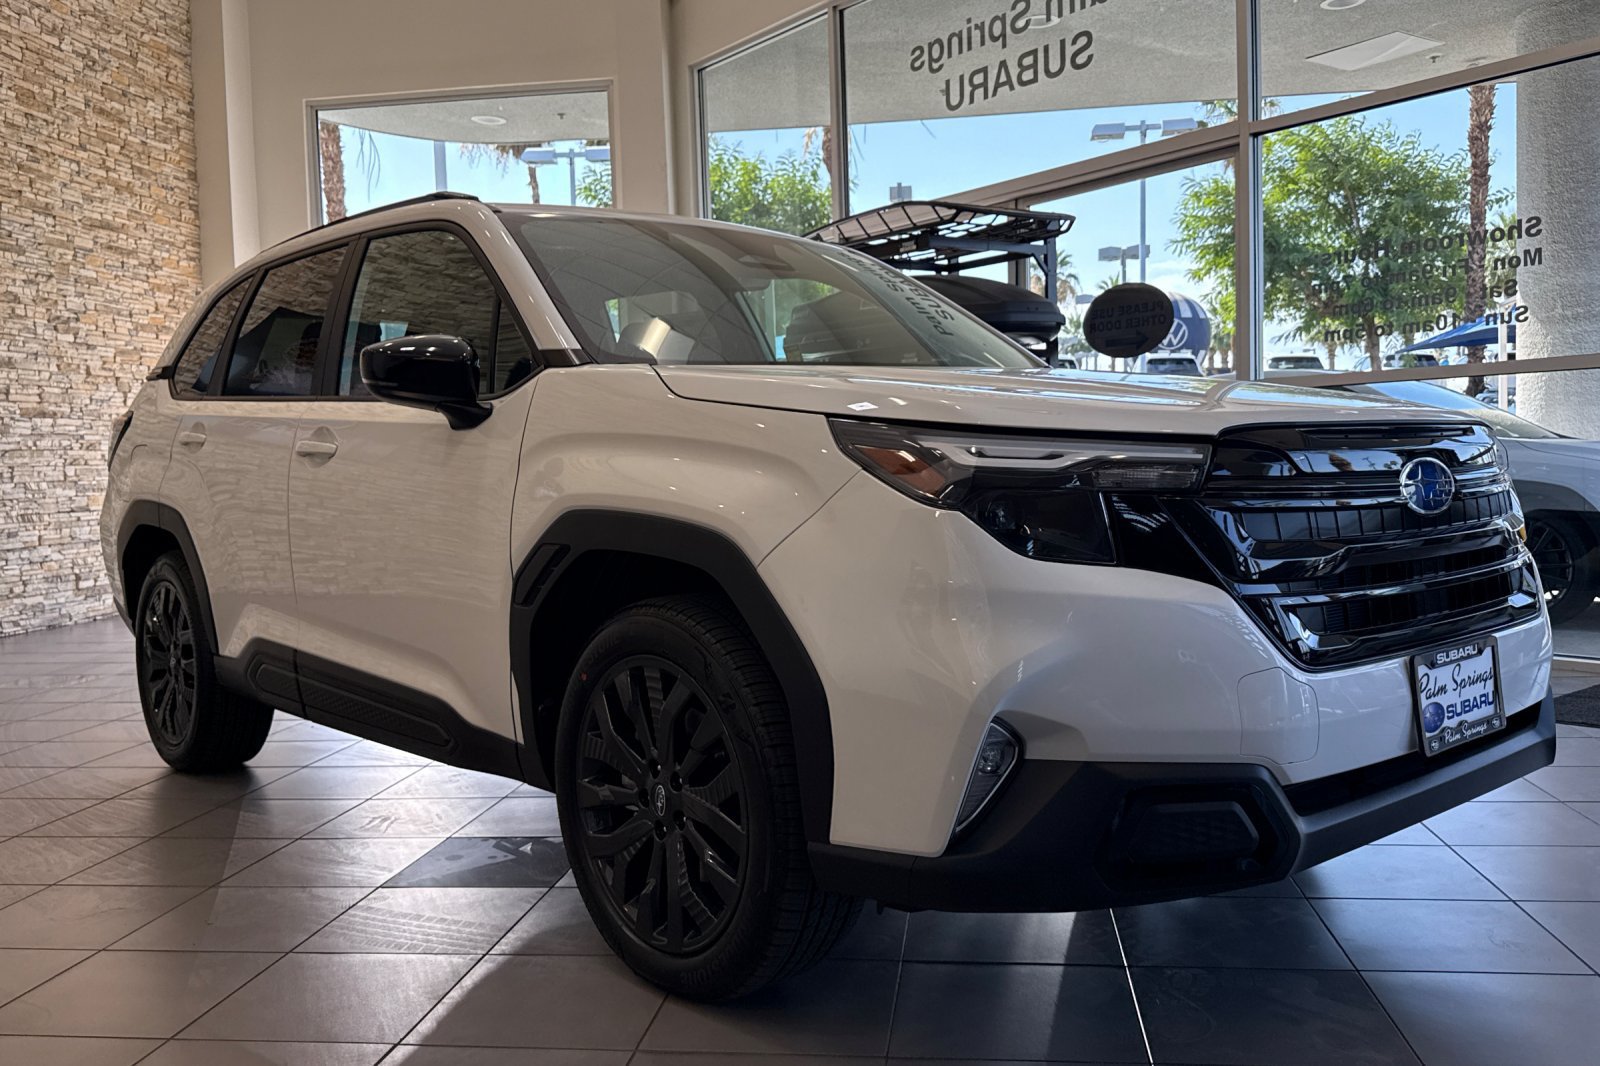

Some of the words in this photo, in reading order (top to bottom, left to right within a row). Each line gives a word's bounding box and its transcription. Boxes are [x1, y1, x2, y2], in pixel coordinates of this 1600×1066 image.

[1437, 645, 1478, 663] SUBARU
[1419, 673, 1448, 700] Palm
[1451, 663, 1494, 698] Springs
[1446, 690, 1495, 720] SUBARU
[1445, 729, 1461, 743] Palm
[1462, 721, 1487, 738] Springs
